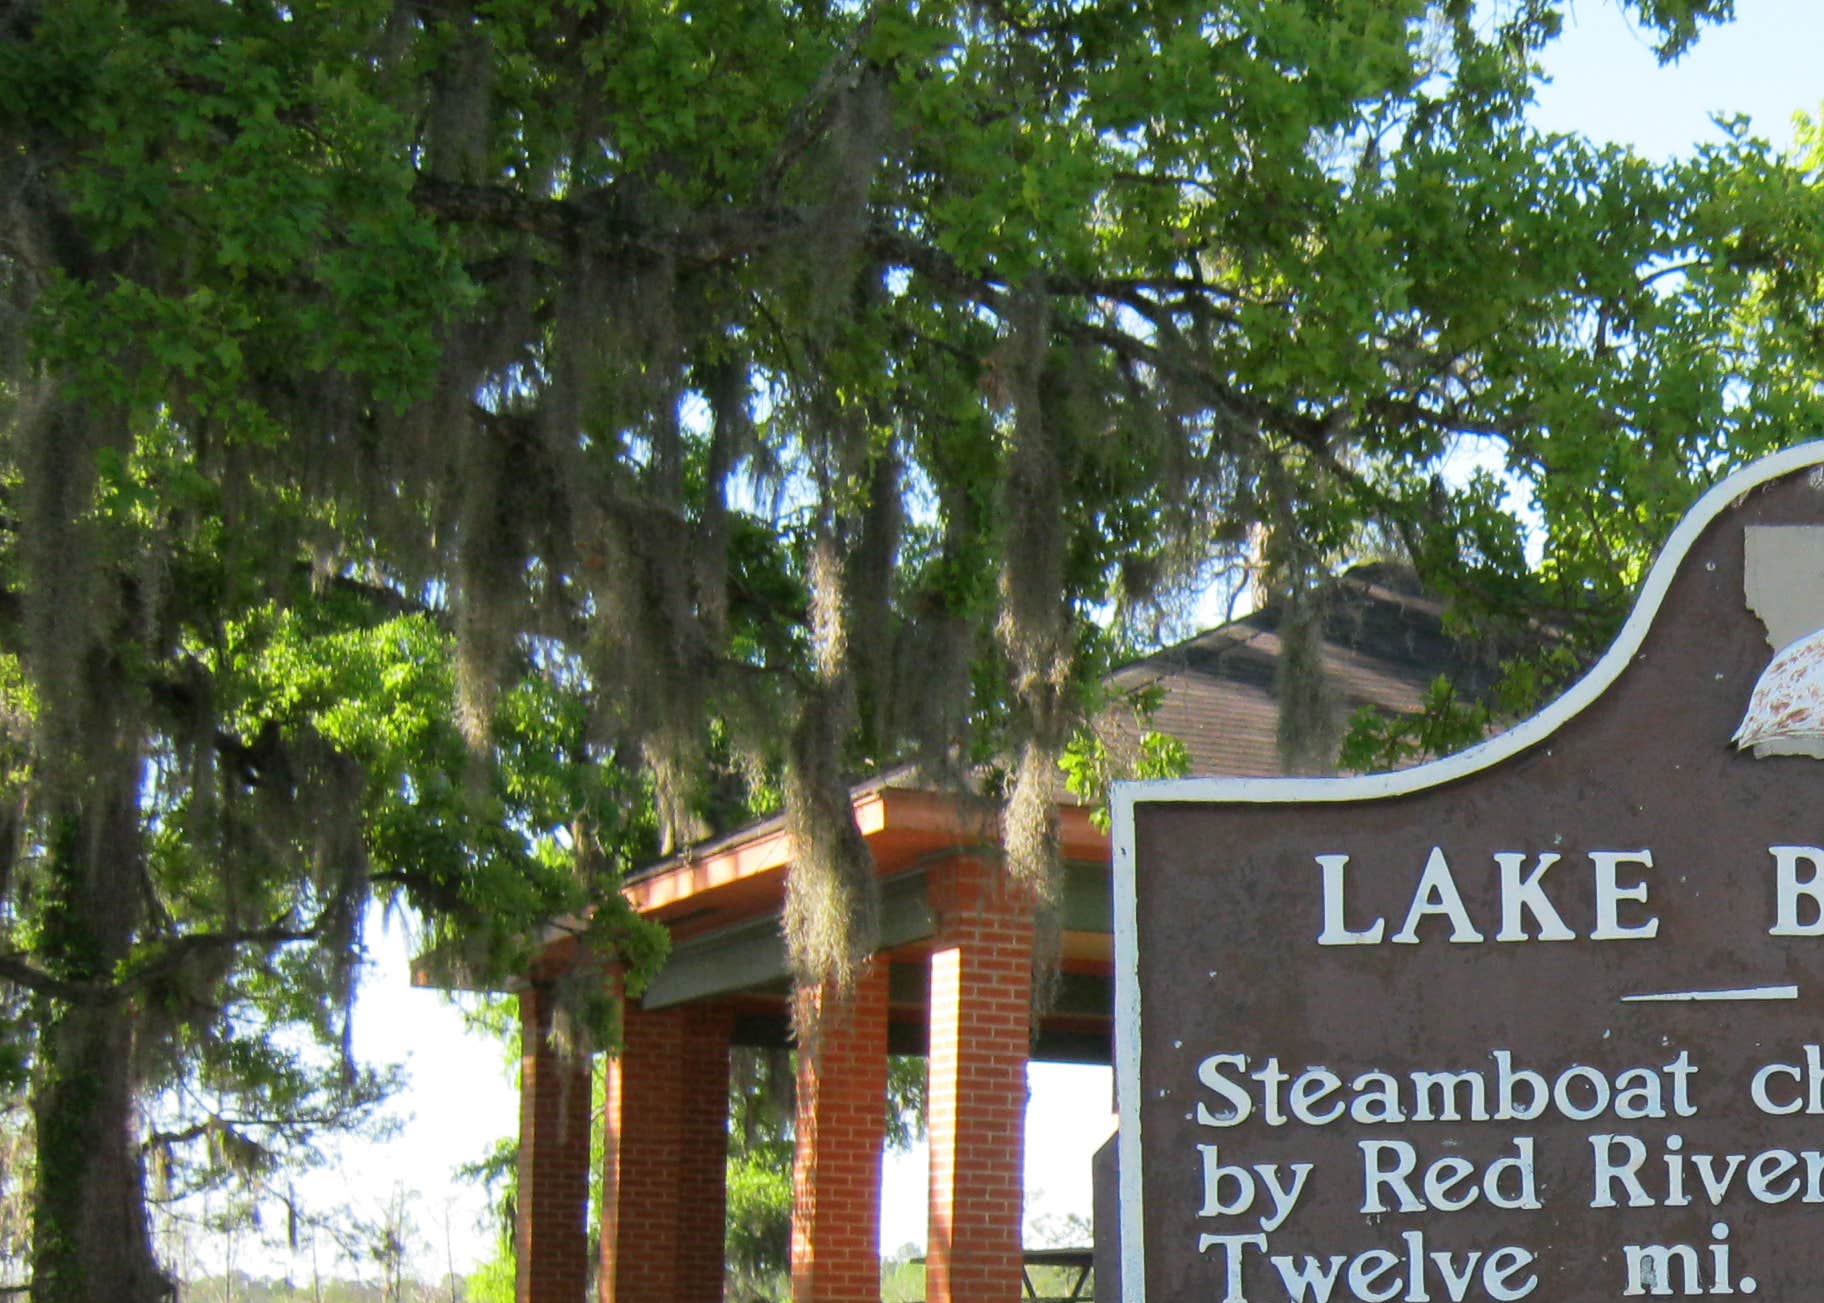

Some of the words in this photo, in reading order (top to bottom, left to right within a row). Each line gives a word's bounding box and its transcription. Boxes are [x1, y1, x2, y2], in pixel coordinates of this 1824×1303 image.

[1314, 846, 1659, 946] LAKE
[1197, 1050, 1699, 1127] Steamboat
[1196, 1143, 1314, 1232] by
[1357, 1136, 1542, 1214] Red
[1622, 1222, 1757, 1296] mi.
